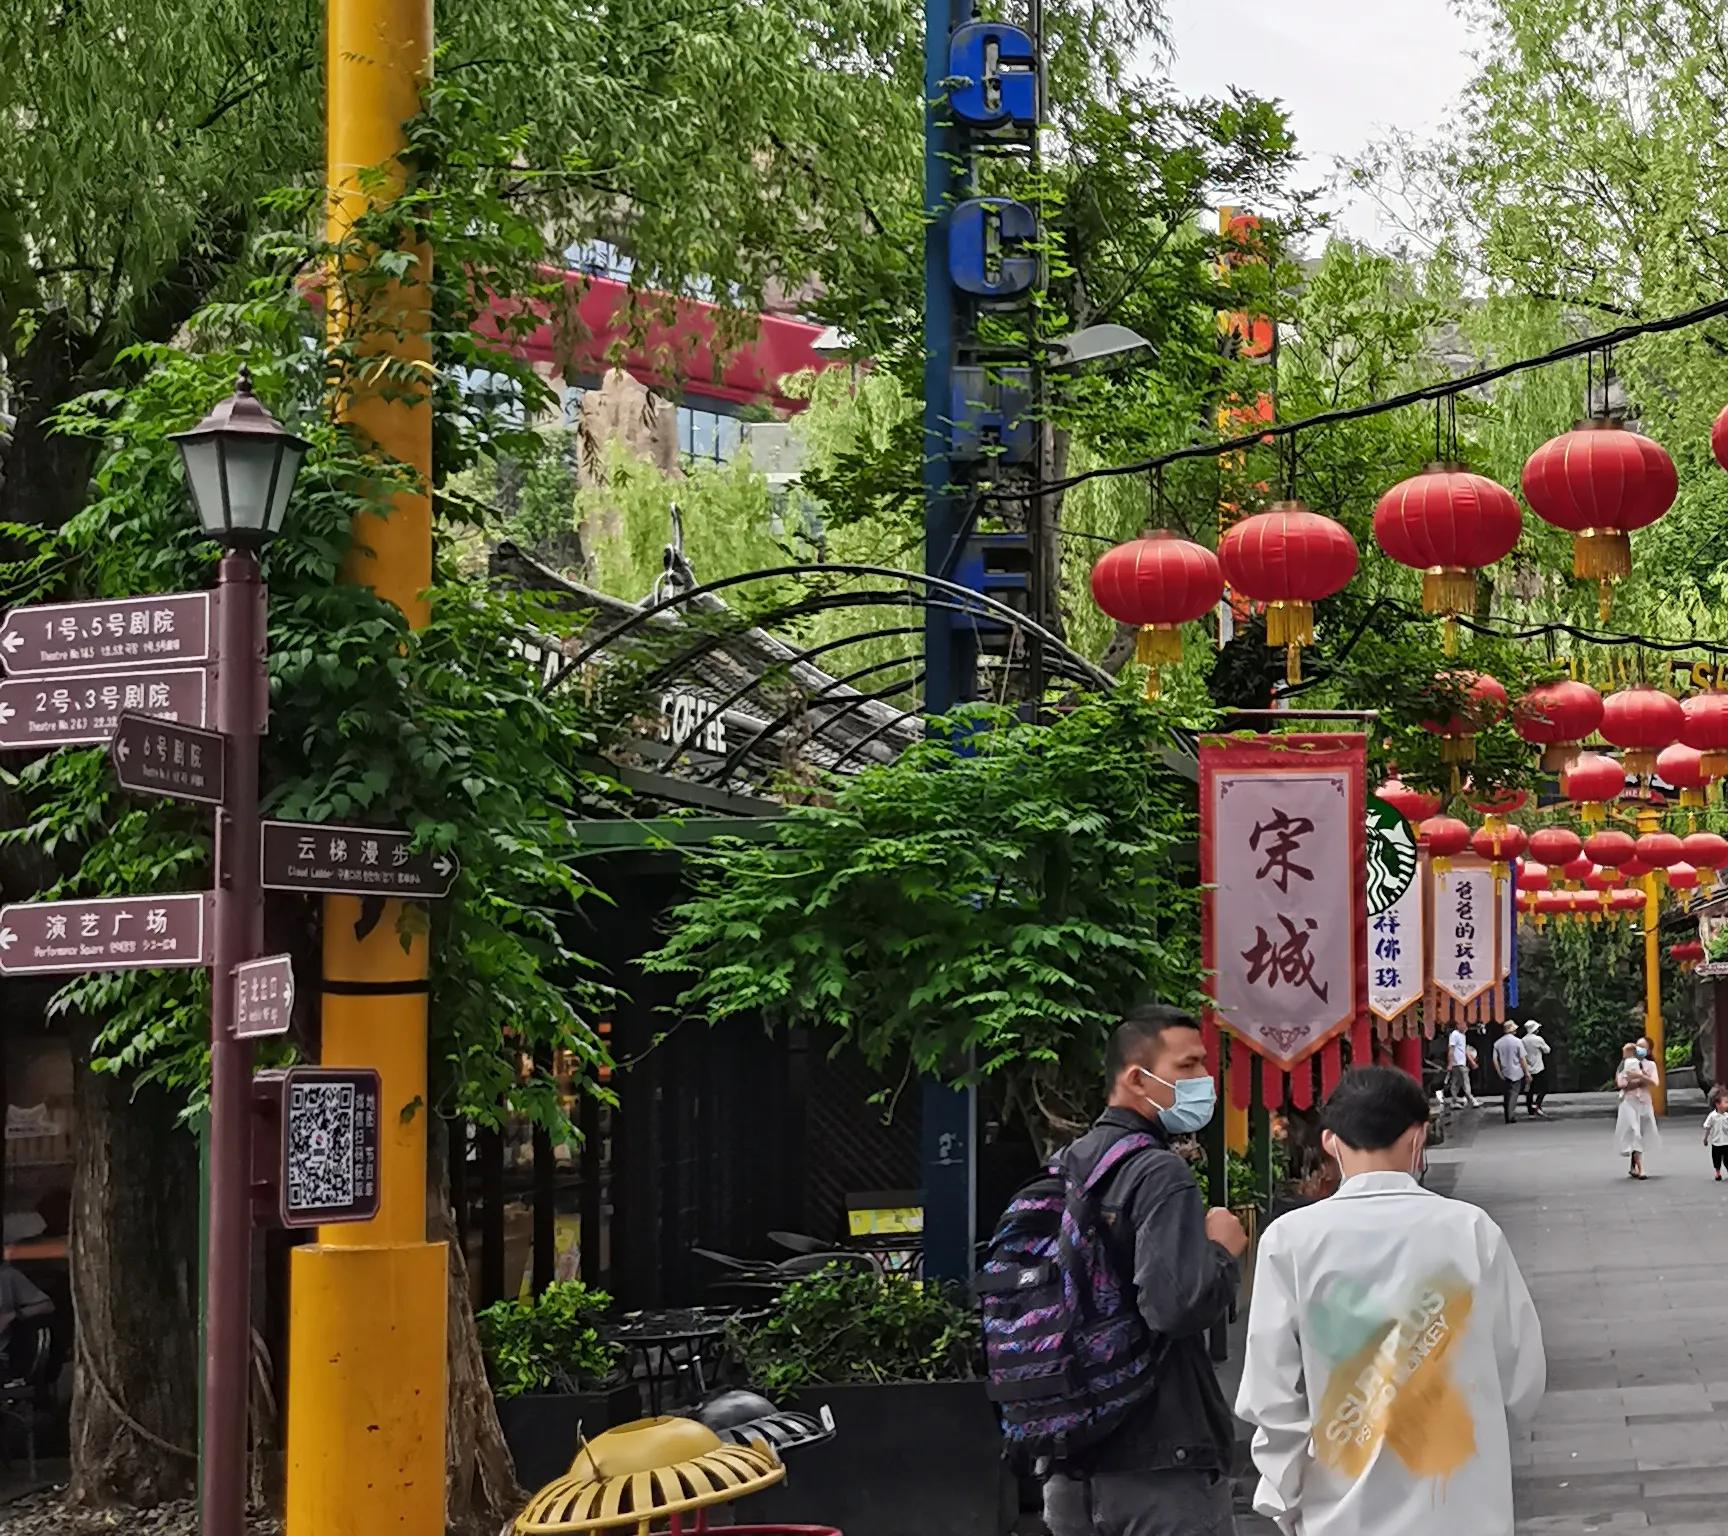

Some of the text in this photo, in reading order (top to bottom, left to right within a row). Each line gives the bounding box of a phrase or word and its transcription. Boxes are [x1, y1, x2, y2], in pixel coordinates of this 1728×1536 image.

[44, 609, 175, 642] 1号、5号剧院
[36, 682, 171, 713] 2号、3号剧院
[298, 836, 409, 867] 云梯漫步
[1241, 807, 1329, 1005] 宋城
[46, 908, 168, 941] 演艺广场
[1455, 880, 1475, 980] 爸爸的玩具
